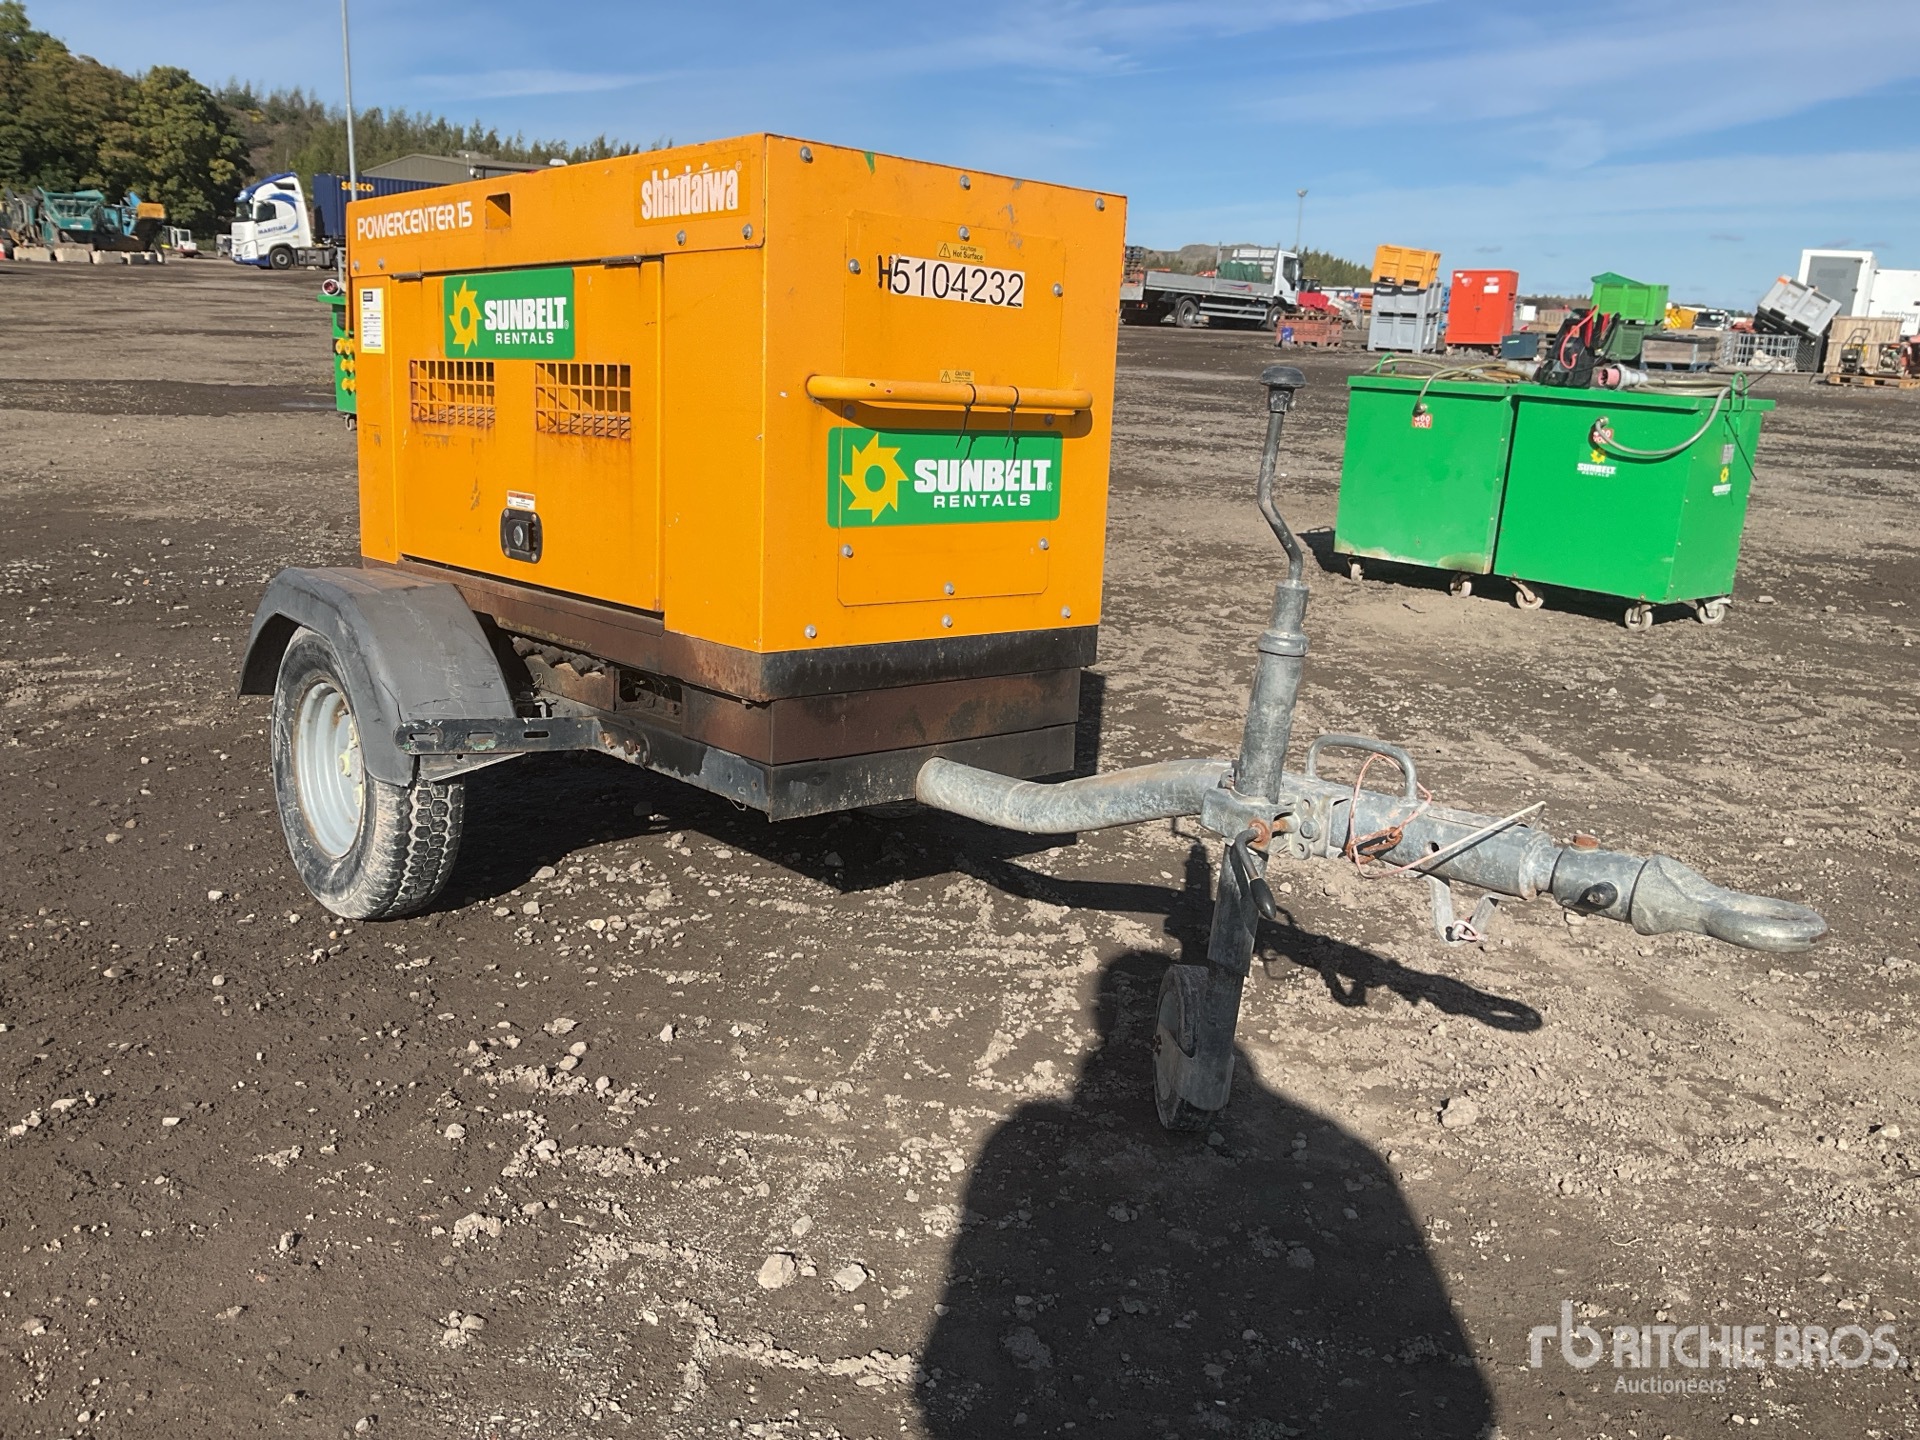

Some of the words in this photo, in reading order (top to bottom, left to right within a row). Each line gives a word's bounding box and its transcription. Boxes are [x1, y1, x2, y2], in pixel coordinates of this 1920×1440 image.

[641, 163, 739, 220] shindaiwa
[357, 203, 456, 240] POWERCENTER
[458, 201, 472, 228] 15
[952, 250, 962, 258] Hot
[963, 252, 983, 260] Surface
[484, 297, 567, 331] SUNBELT
[495, 332, 555, 345] RENTALS
[914, 459, 1051, 493] SUNBELT
[933, 494, 1031, 508] RENTALS
